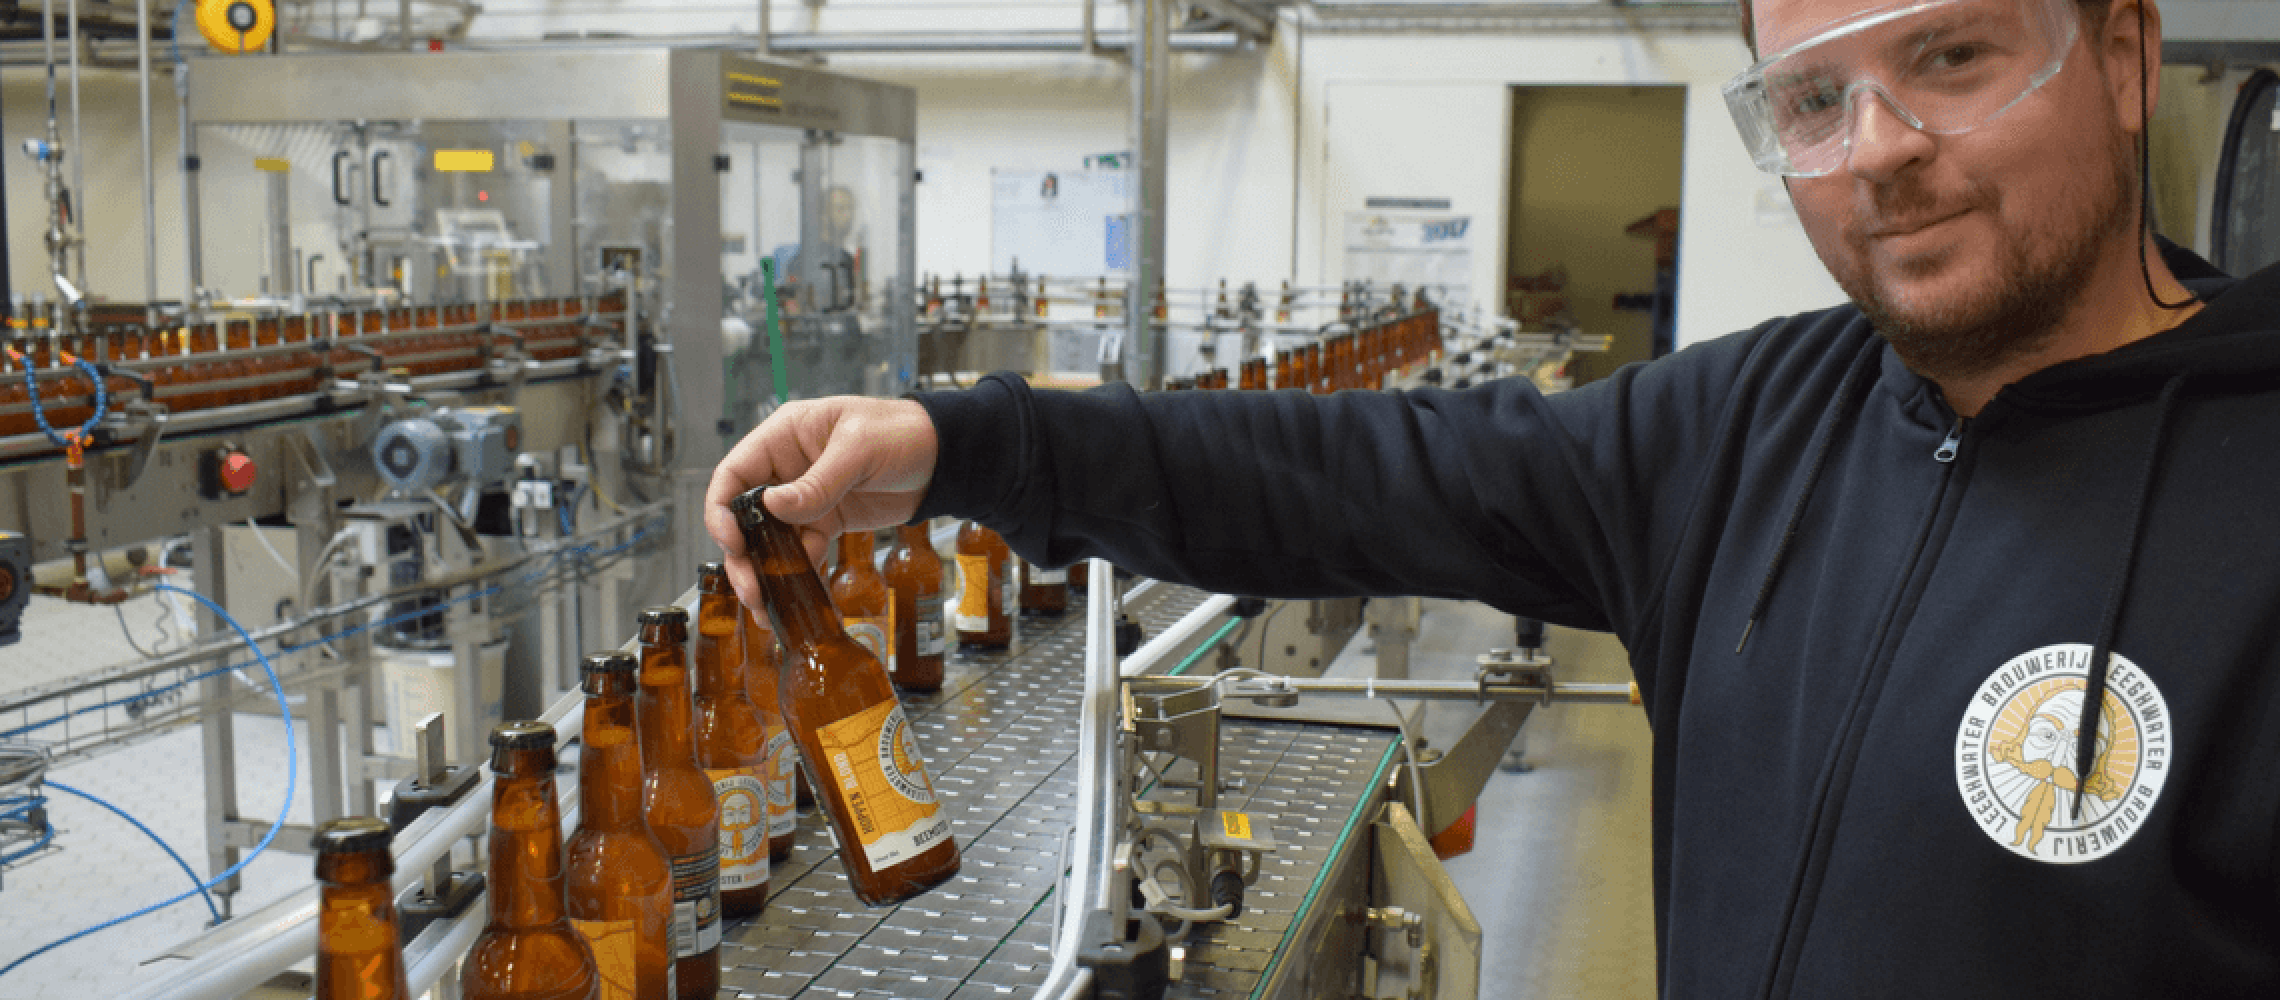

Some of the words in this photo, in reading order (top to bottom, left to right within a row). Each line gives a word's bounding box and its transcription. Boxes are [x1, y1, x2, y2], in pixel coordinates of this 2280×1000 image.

[1981, 650, 2090, 707] BROUWERIJ
[2109, 664, 2165, 771] EEGHWATER
[850, 791, 874, 834] HOPPEN
[1961, 715, 2009, 834] LEEGHWATER
[2053, 784, 2154, 857] BROUWERIJ
